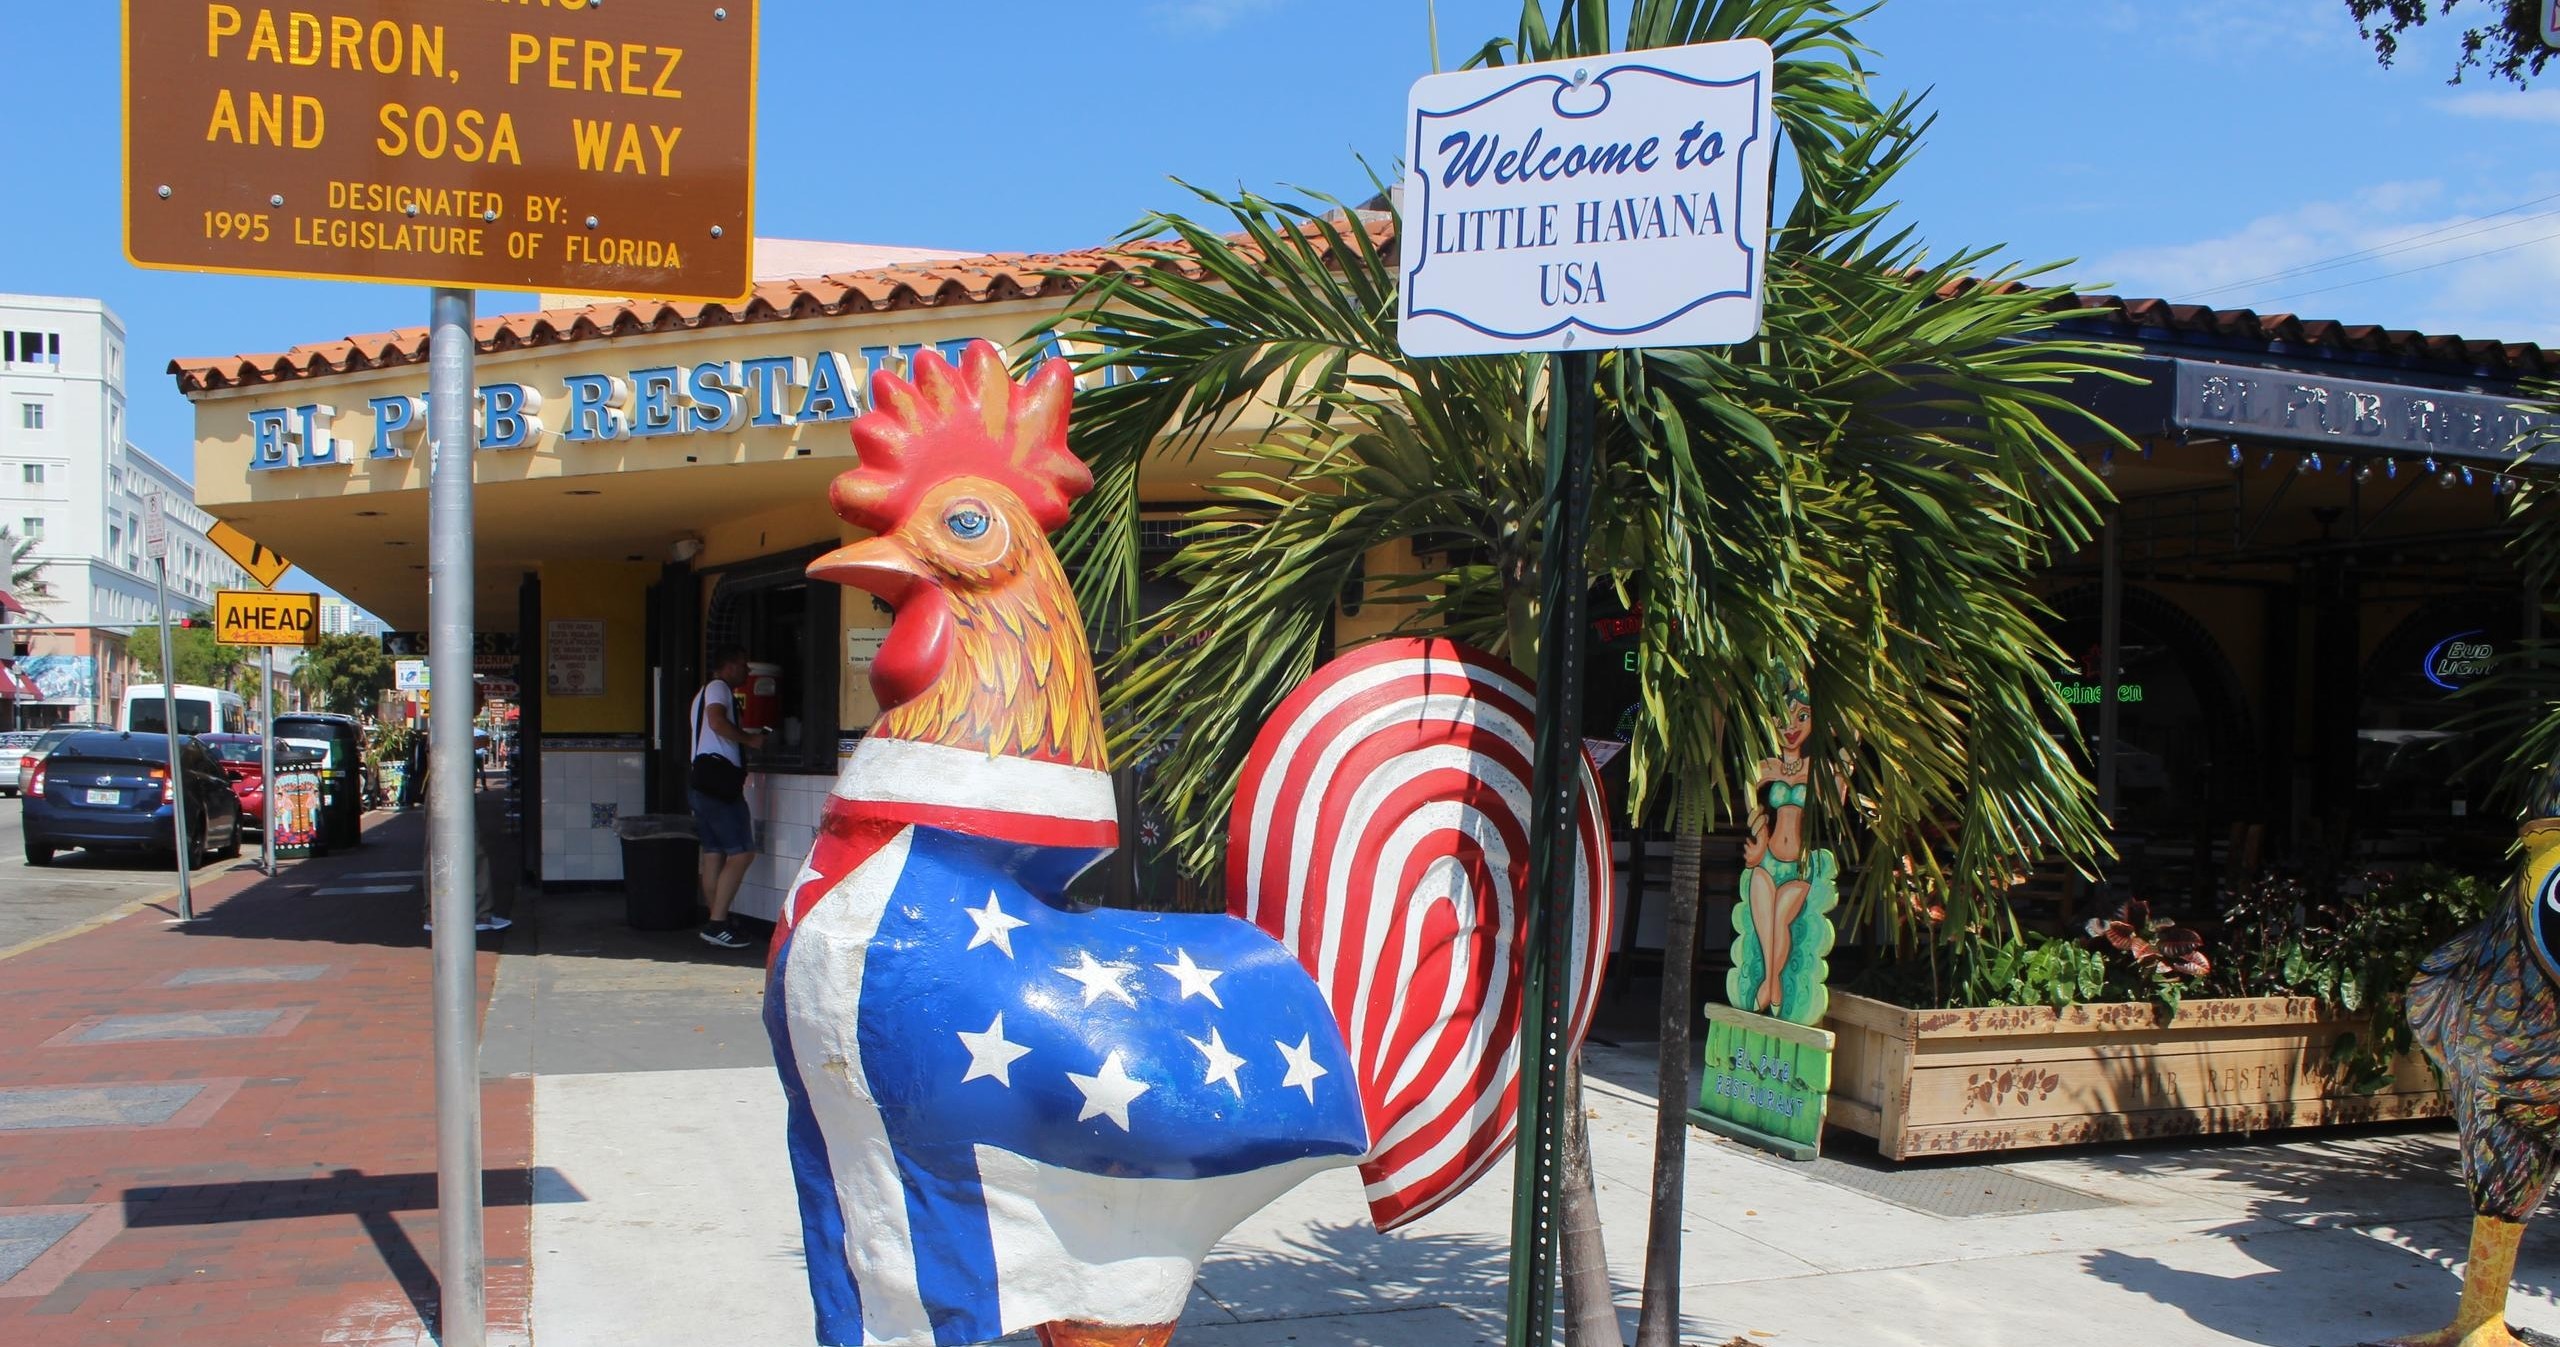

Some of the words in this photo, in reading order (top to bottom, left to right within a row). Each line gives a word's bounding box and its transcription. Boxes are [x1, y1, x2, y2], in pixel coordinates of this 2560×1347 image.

[207, 3, 459, 84] PADRON,
[509, 33, 683, 98] PEREZ
[206, 88, 325, 149] AND
[376, 102, 521, 165] SOSA
[573, 118, 682, 177] WAY
[1438, 127, 1659, 189] Welcome
[1675, 120, 1725, 170] to
[328, 181, 503, 220] DESIGNATED
[527, 195, 567, 224] BY:
[1433, 204, 1559, 255] LITTLE
[1573, 191, 1724, 245] HAVANA
[204, 210, 270, 242] 1995
[295, 217, 483, 256] LEGISLATURE
[508, 231, 543, 259] OF
[566, 235, 681, 269] FLORIDA
[1539, 260, 1606, 307] USA
[249, 403, 352, 472] EL
[369, 382, 542, 460] PB
[225, 606, 313, 631] AHEAD
[2045, 681, 2143, 704] eineen
[1735, 1047, 1751, 1071] EL
[1760, 1054, 1791, 1082] PUB
[2131, 1070, 2177, 1098] PUB
[1716, 1073, 1804, 1117] RESTAURANT
